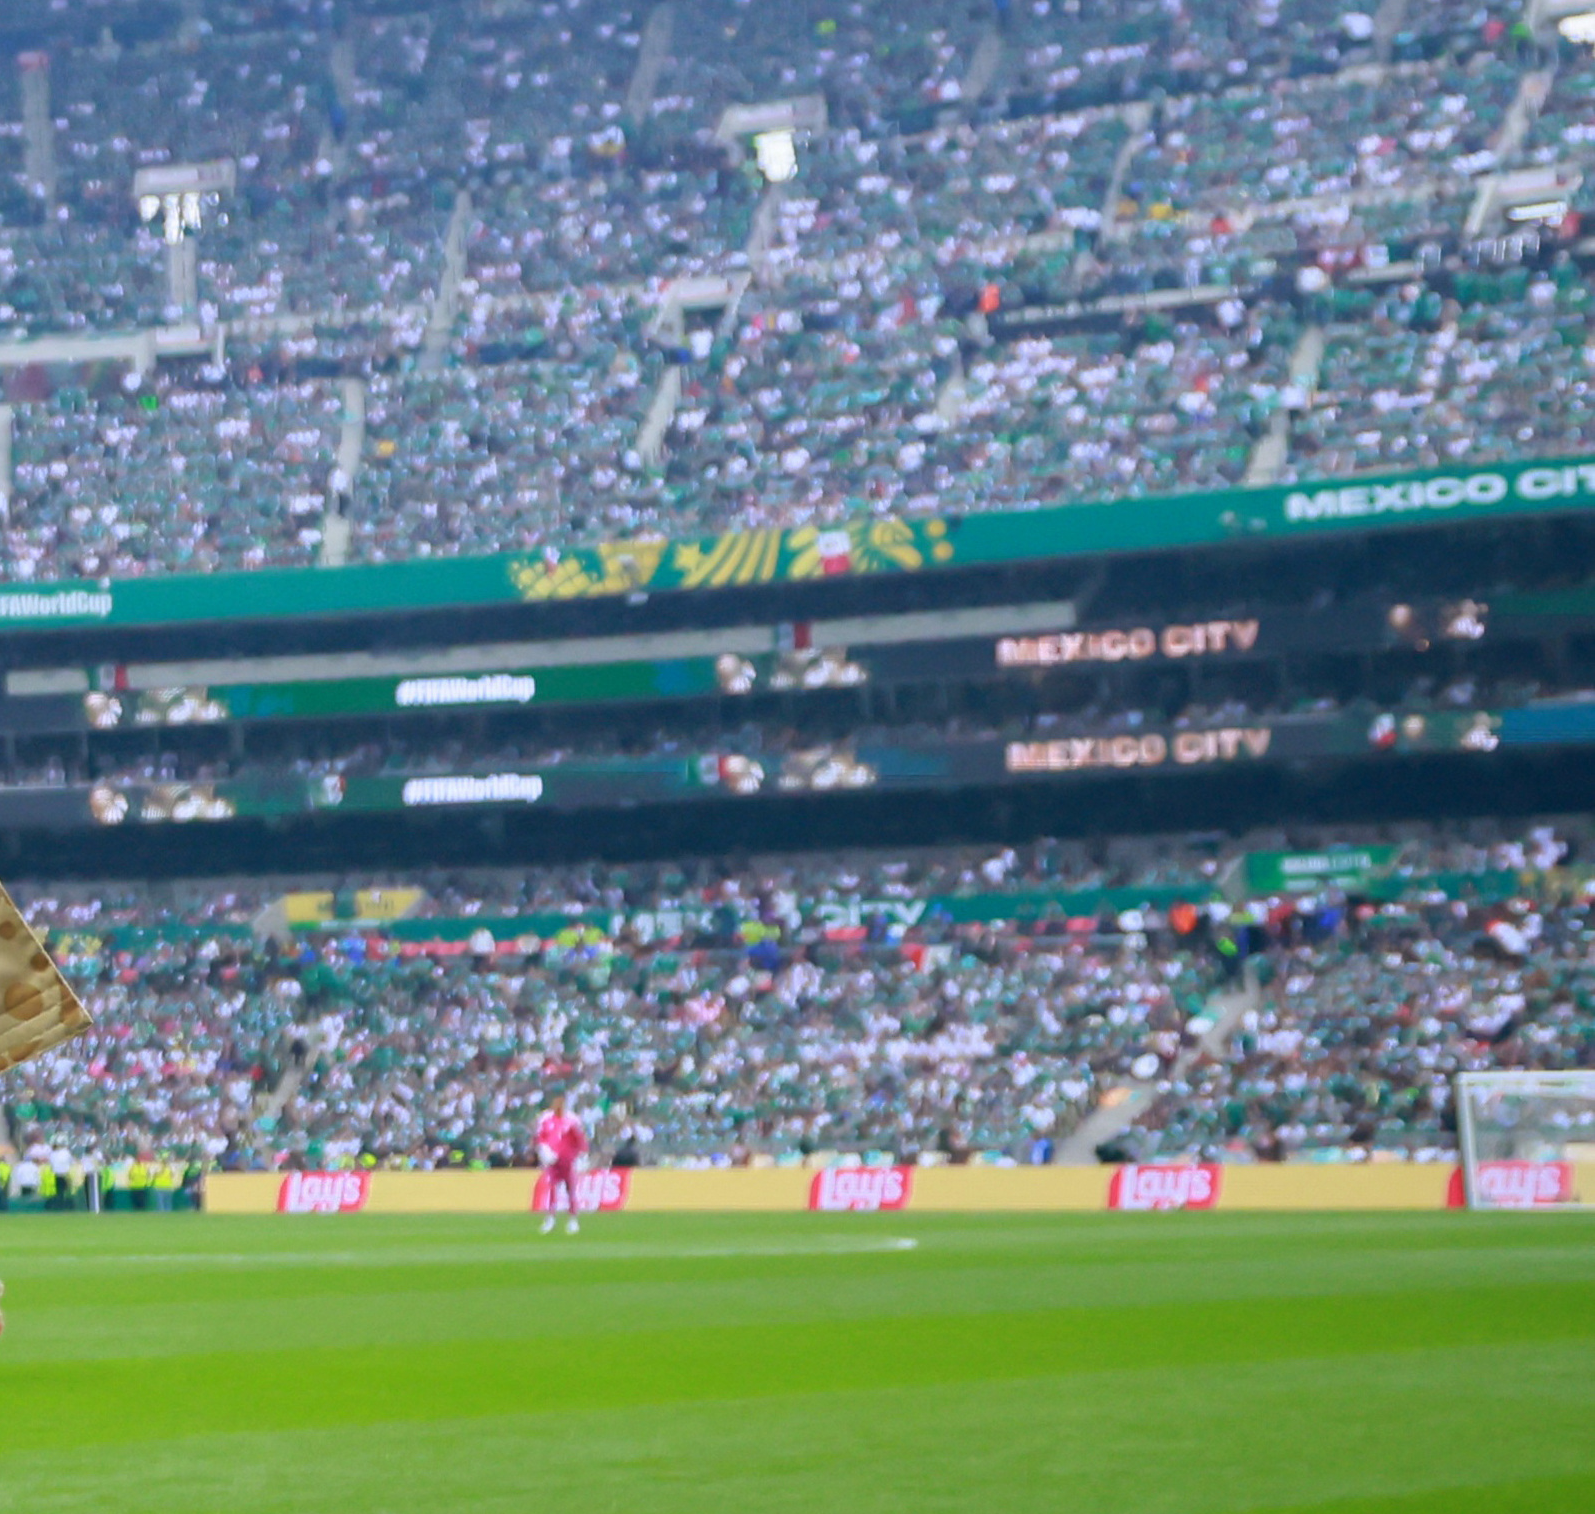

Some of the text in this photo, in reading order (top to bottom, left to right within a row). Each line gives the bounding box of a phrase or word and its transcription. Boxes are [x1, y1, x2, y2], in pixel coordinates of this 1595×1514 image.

[1284, 472, 1508, 522] MEXICO
[995, 618, 1259, 667] MEXICO CITY
[1005, 728, 1271, 773] MEXICO CITY
[285, 1170, 362, 1213] Lay's
[820, 1166, 904, 1210] Lay's
[1119, 1164, 1212, 1210] Lay's
